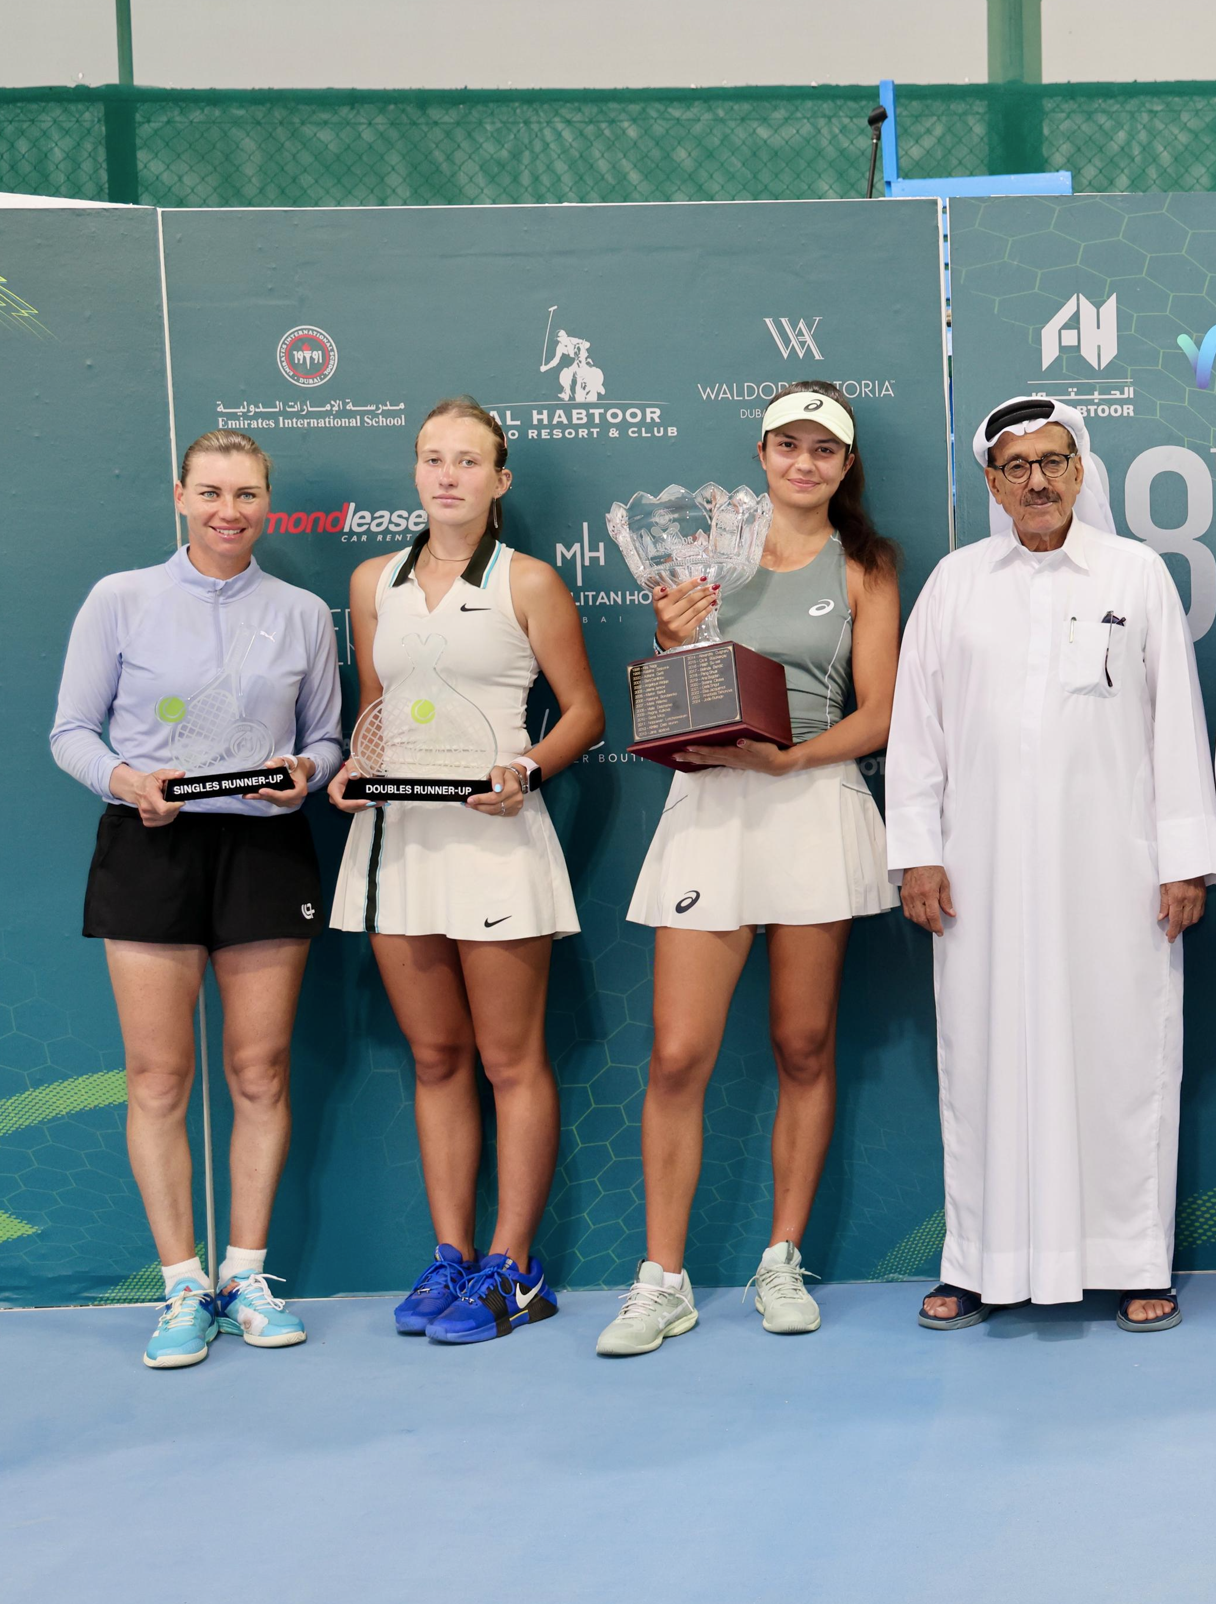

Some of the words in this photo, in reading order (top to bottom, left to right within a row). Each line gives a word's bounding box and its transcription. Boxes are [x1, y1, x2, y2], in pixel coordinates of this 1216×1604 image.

[216, 401, 283, 416] الدولية
[286, 399, 343, 415] الإمارات
[346, 399, 405, 414] مدرسة
[1075, 404, 1134, 417] BTOOR
[218, 417, 275, 429] Emirates
[279, 416, 360, 428] International
[364, 415, 405, 426] School
[532, 407, 661, 425] HABTOOR
[528, 428, 600, 439] RESORT
[608, 427, 620, 438] &
[628, 426, 678, 438] CLUB
[266, 502, 428, 534] mondlease
[341, 534, 368, 543] CAR
[376, 533, 413, 542] RENT
[173, 781, 220, 795] SINGLES
[221, 774, 284, 790] RUNNER-UP
[365, 783, 412, 794] DOUBLES
[413, 785, 472, 796] RUNNER-UP
